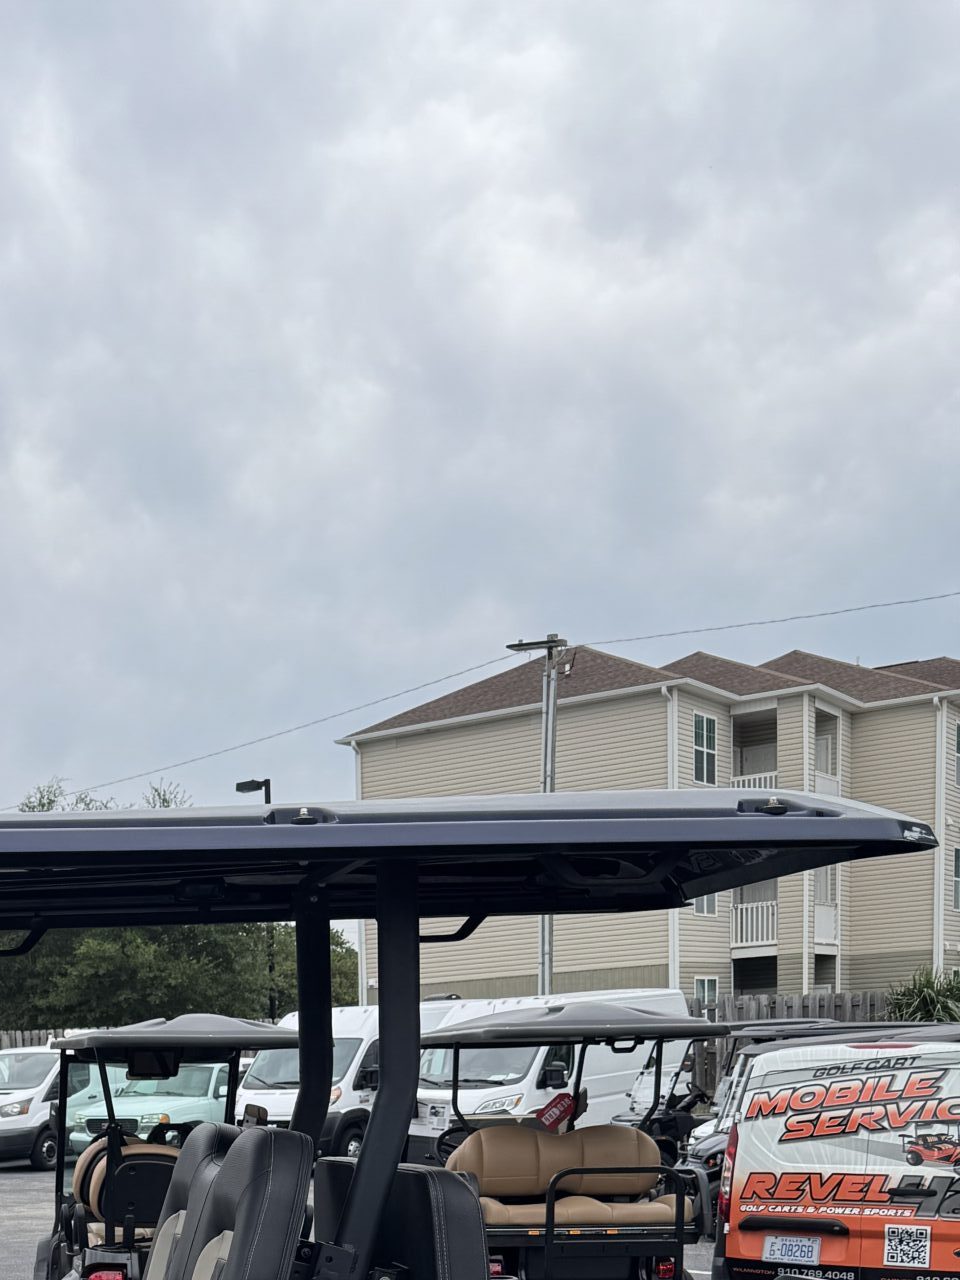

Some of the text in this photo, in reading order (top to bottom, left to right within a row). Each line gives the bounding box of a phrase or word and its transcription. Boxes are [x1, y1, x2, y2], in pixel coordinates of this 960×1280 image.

[812, 1056, 922, 1078] GOLF CART
[745, 1068, 948, 1119] MOBILE
[740, 1204, 765, 1212] GOLF
[768, 1205, 804, 1213] CARTS
[817, 1206, 860, 1215] POWER
[862, 1208, 913, 1217] SPORTS
[777, 1267, 855, 1280] 910769.4048
